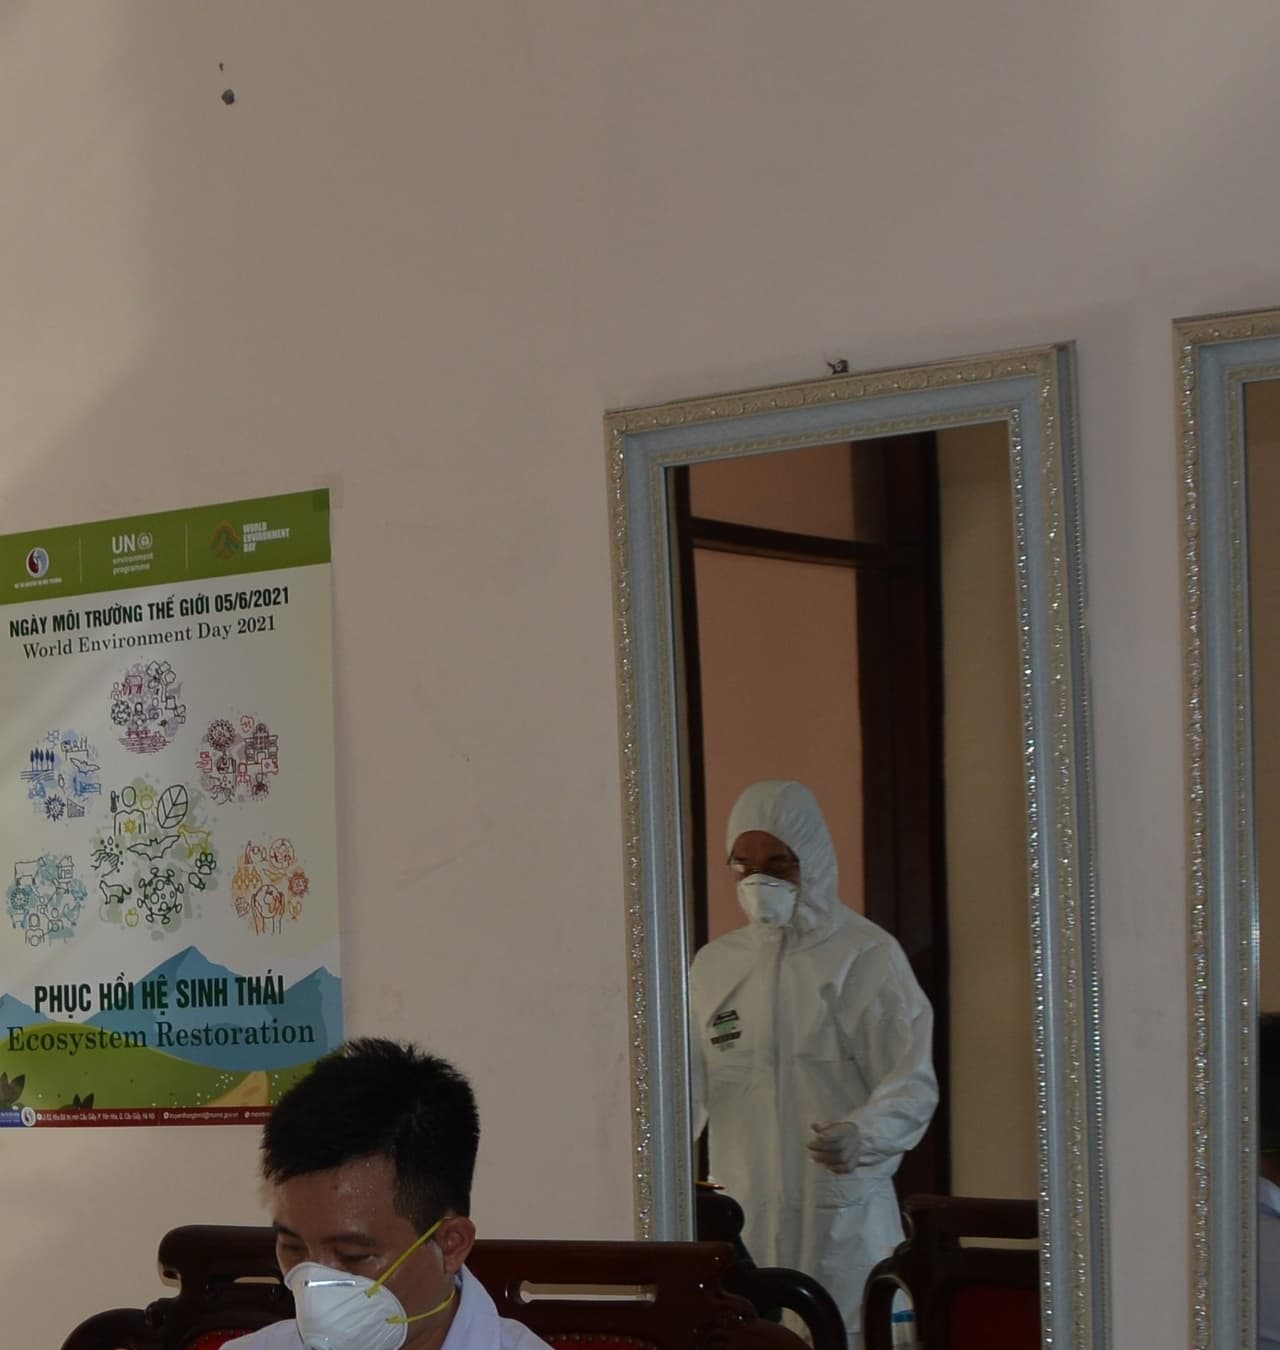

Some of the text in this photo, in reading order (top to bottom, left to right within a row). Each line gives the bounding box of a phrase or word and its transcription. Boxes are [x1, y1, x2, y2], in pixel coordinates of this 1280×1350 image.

[243, 522, 268, 533] WORLD
[112, 533, 135, 554] UN
[243, 542, 256, 553] DAY
[113, 552, 154, 565] environment
[113, 563, 151, 576] programme
[10, 586, 290, 638] NGÀY MÔI TRƯỜNG THẾ GIỚI 05/6/2021
[23, 614, 276, 660] World Environment Day 2021
[34, 969, 285, 1019] PHỤC HỒI HỆ SINH THÁI
[6, 1025, 147, 1056] Ecosystem
[156, 1018, 316, 1048] Restoration
